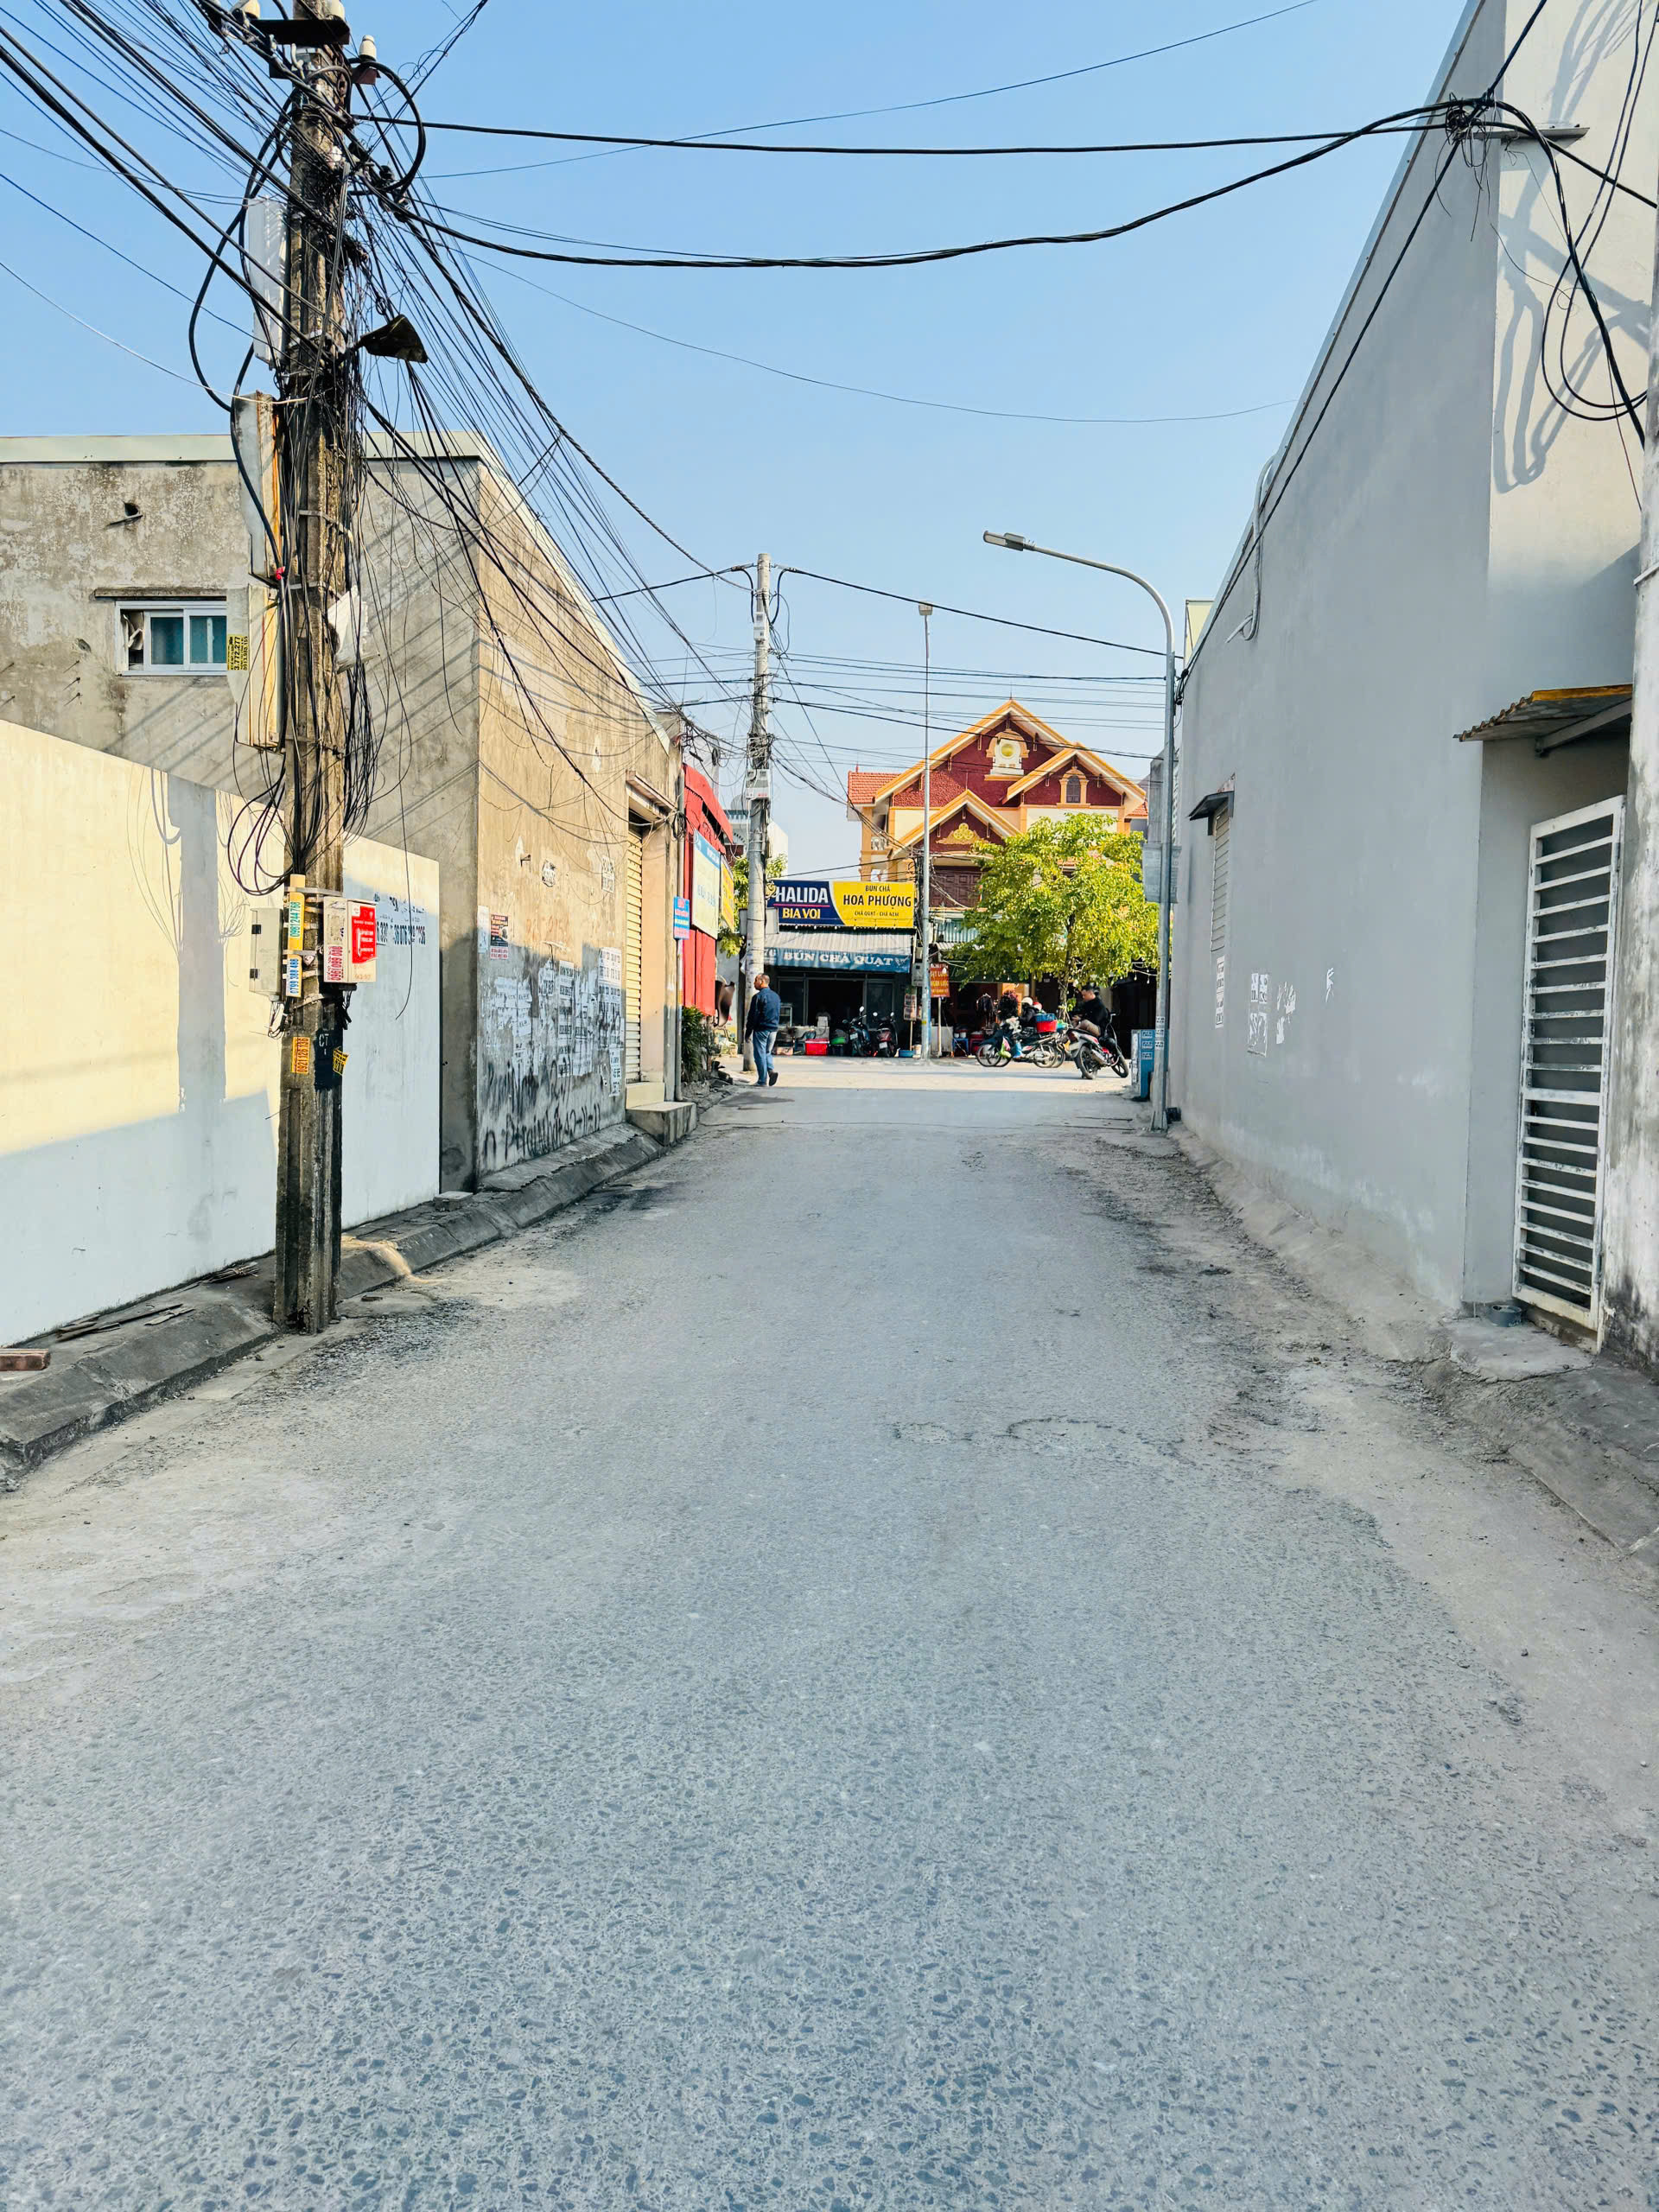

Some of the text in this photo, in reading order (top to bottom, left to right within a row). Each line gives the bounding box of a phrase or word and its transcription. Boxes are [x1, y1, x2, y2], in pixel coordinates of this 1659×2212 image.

[776, 887, 829, 904] HALIDA
[843, 894, 912, 909] HOA PHƯỢNG
[782, 907, 803, 919] BIA
[784, 950, 815, 962] BÚN
[819, 951, 850, 963] CHẢ
[854, 955, 893, 968] QUẠT
